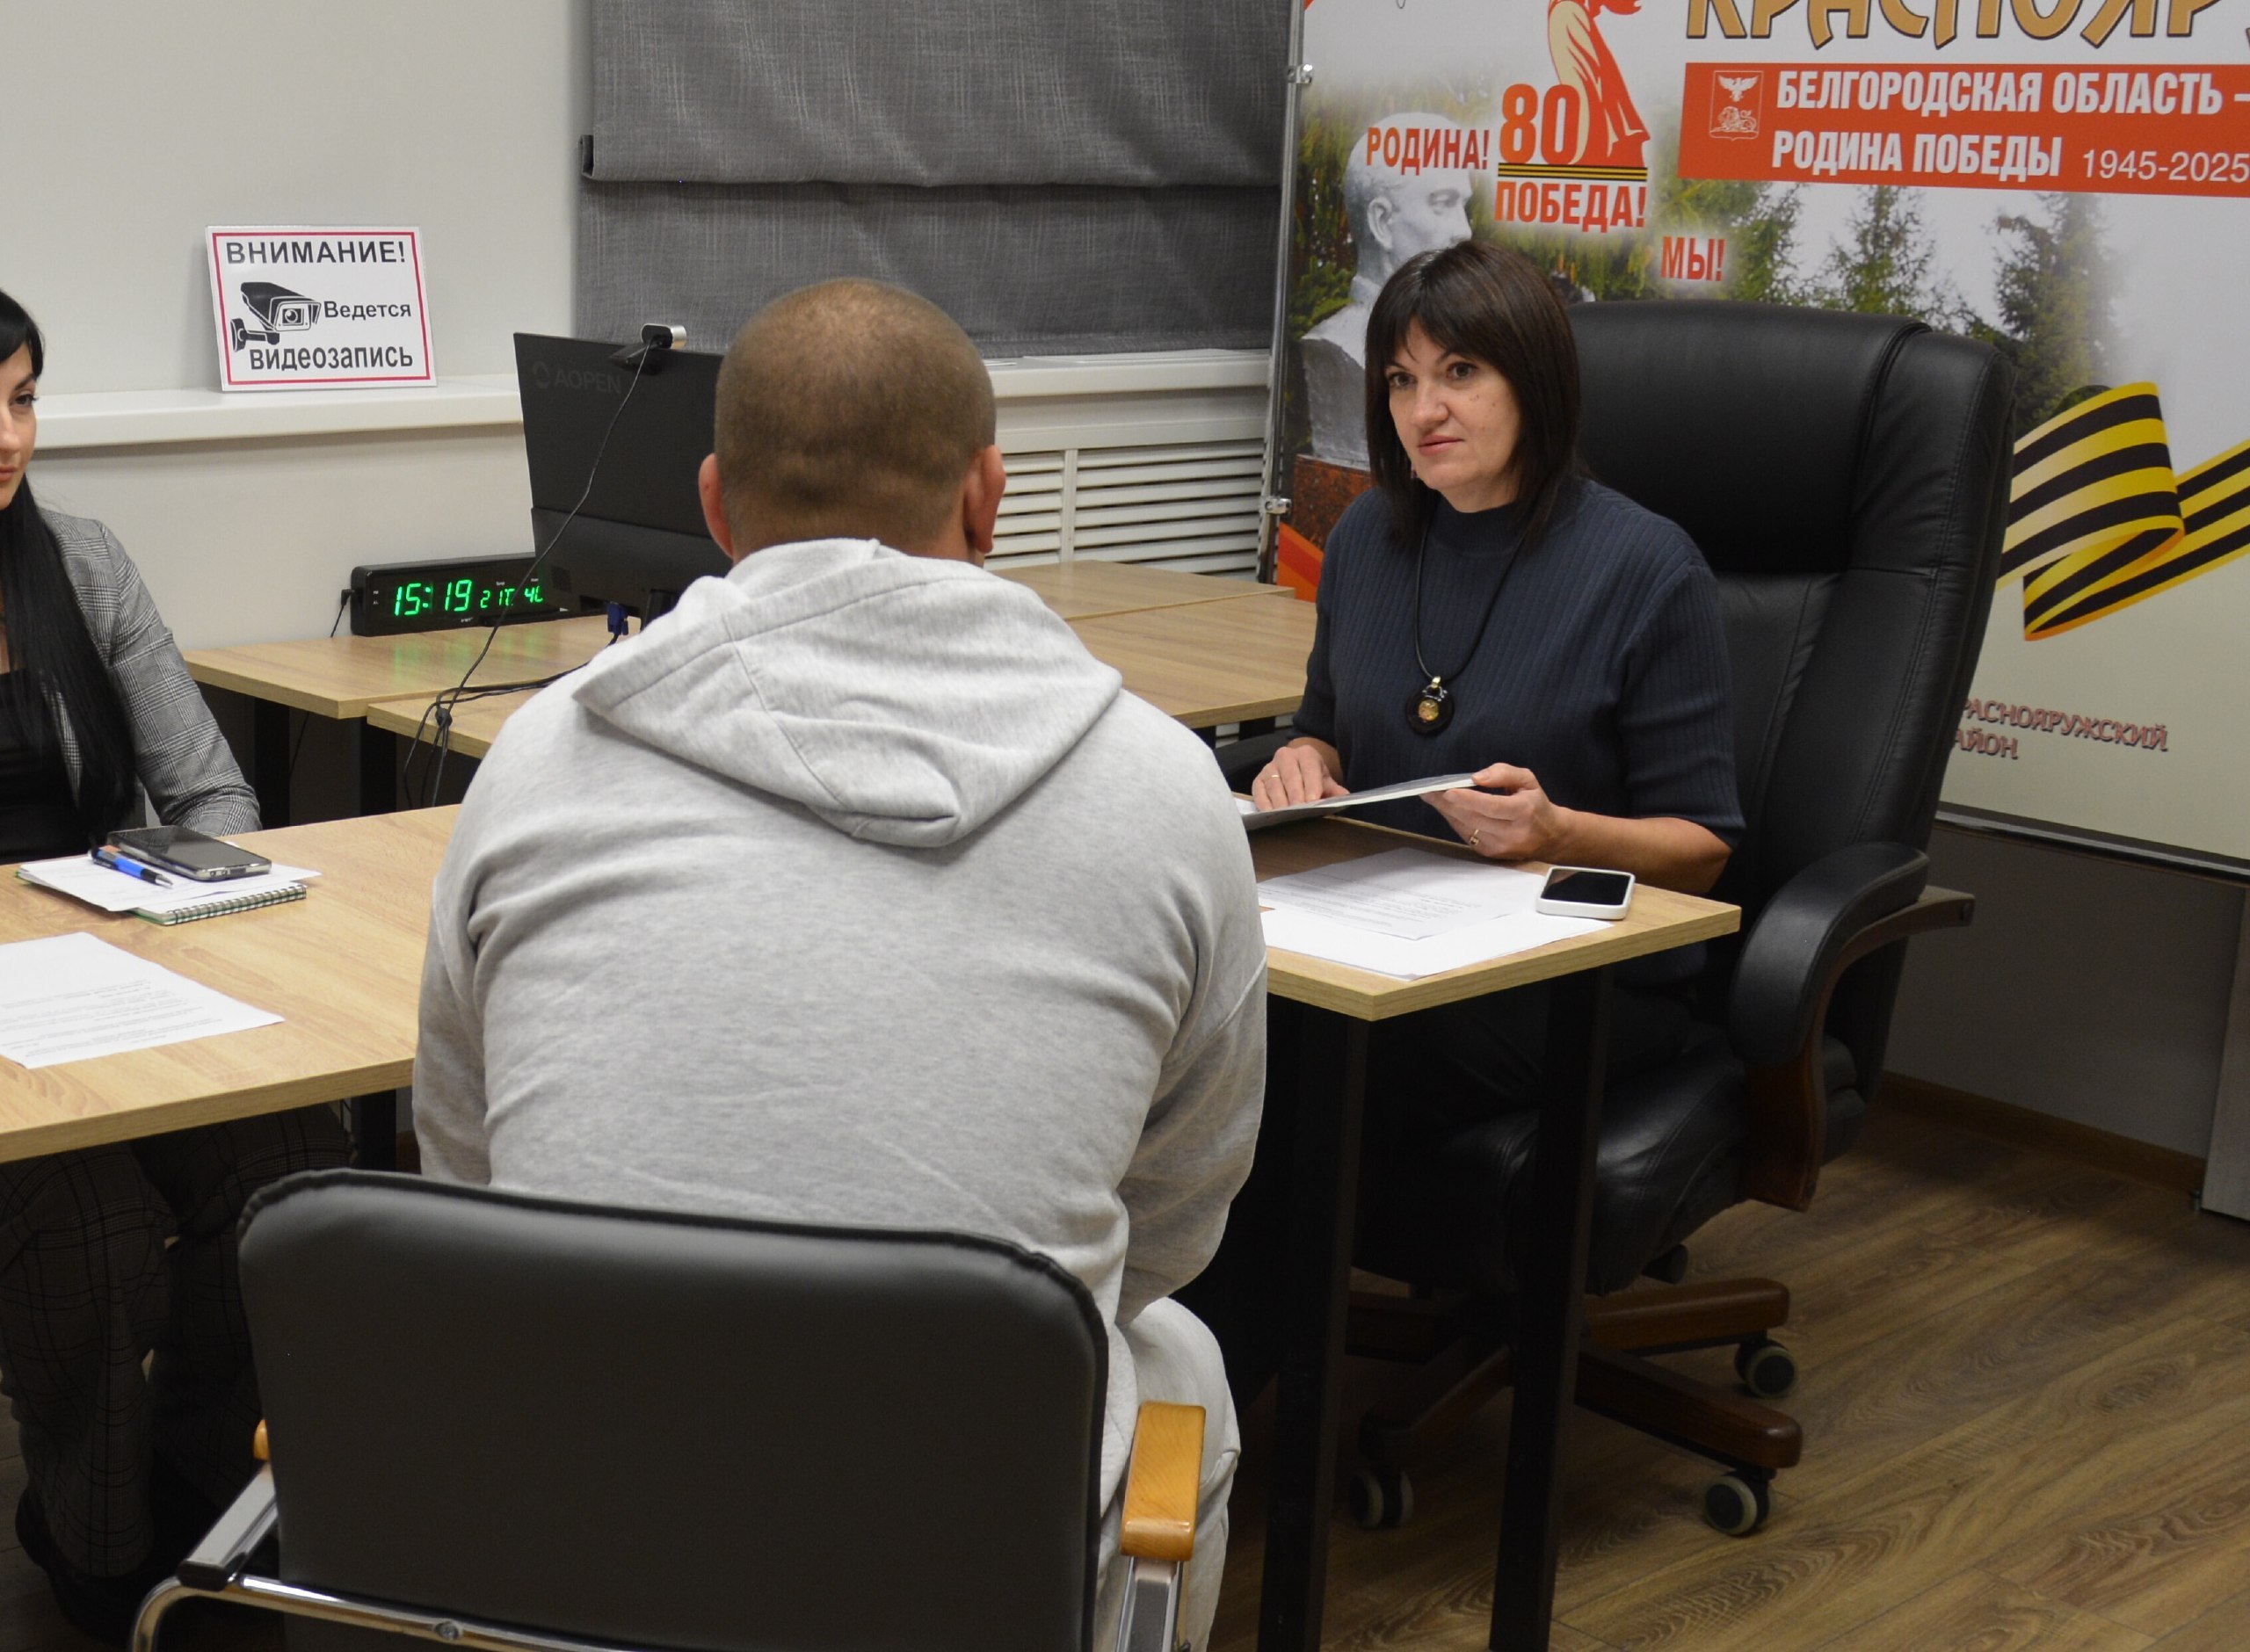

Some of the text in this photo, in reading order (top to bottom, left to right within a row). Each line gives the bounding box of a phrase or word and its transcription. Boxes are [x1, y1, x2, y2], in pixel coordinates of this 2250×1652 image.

[1776, 70, 2043, 118] БЕЛГОРОДСКАЯ
[2052, 72, 2223, 115] ОБЛАСТЬ
[1499, 83, 1585, 165] 80
[1366, 127, 1489, 176] РОДИНА!
[1772, 130, 2250, 183] РОДИНА ПОБЕДЫ 1945-2025
[1495, 181, 1646, 233] ПОБЕДА!
[226, 241, 405, 264] ВНИМАНИЕ!
[1660, 235, 1725, 280] МЫ!
[323, 301, 411, 320] Ведется
[555, 370, 622, 394] AOPEN
[395, 579, 472, 616] 15:19
